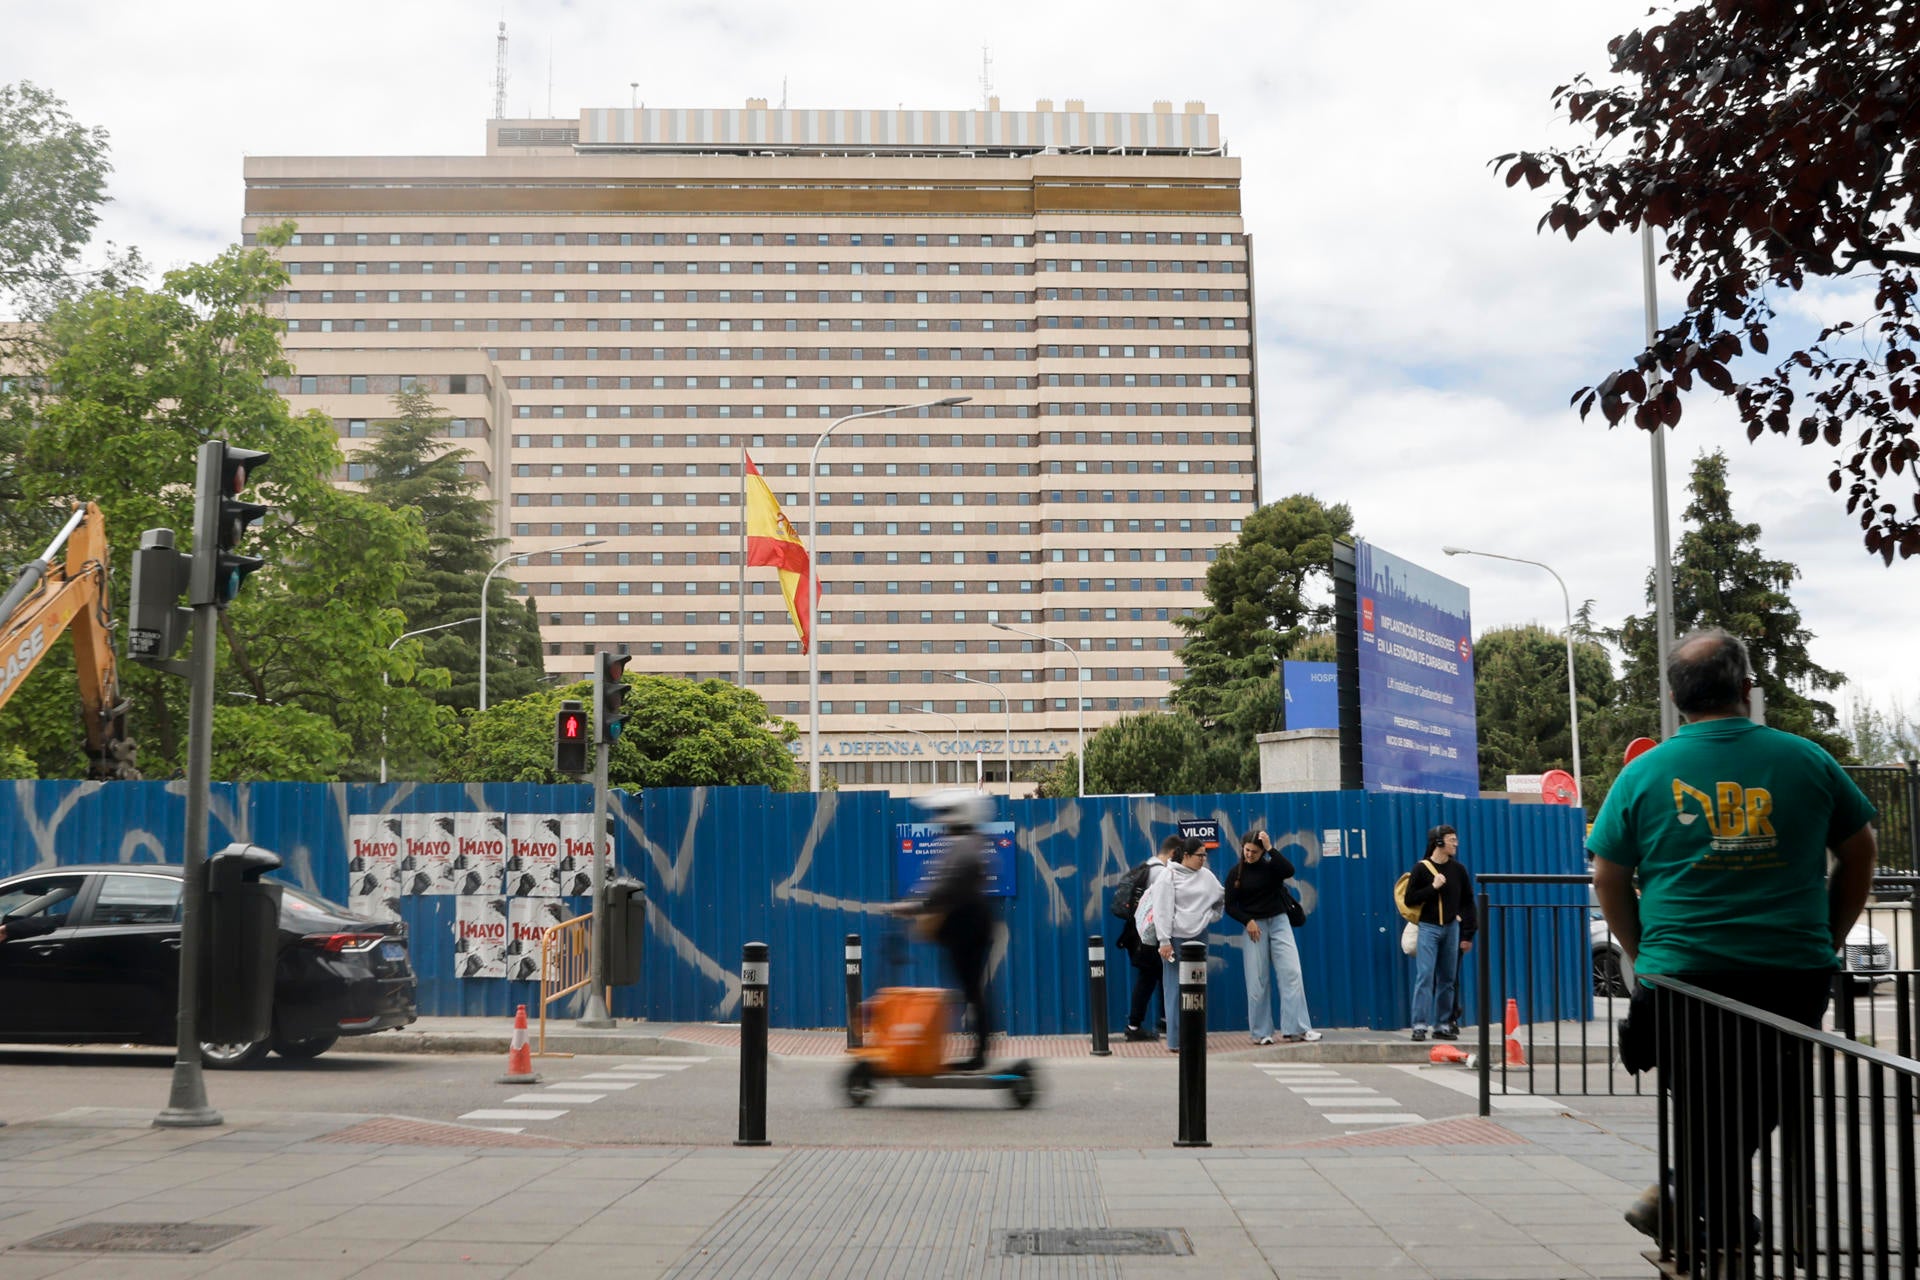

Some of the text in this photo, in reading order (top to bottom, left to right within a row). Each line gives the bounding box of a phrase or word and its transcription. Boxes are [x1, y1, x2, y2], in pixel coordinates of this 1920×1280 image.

[839, 741, 924, 756] DEFENSA
[1182, 827, 1216, 838] VILOR
[572, 842, 611, 856] MAO
[743, 989, 765, 1007] TM54
[1181, 993, 1204, 1011] TM54
